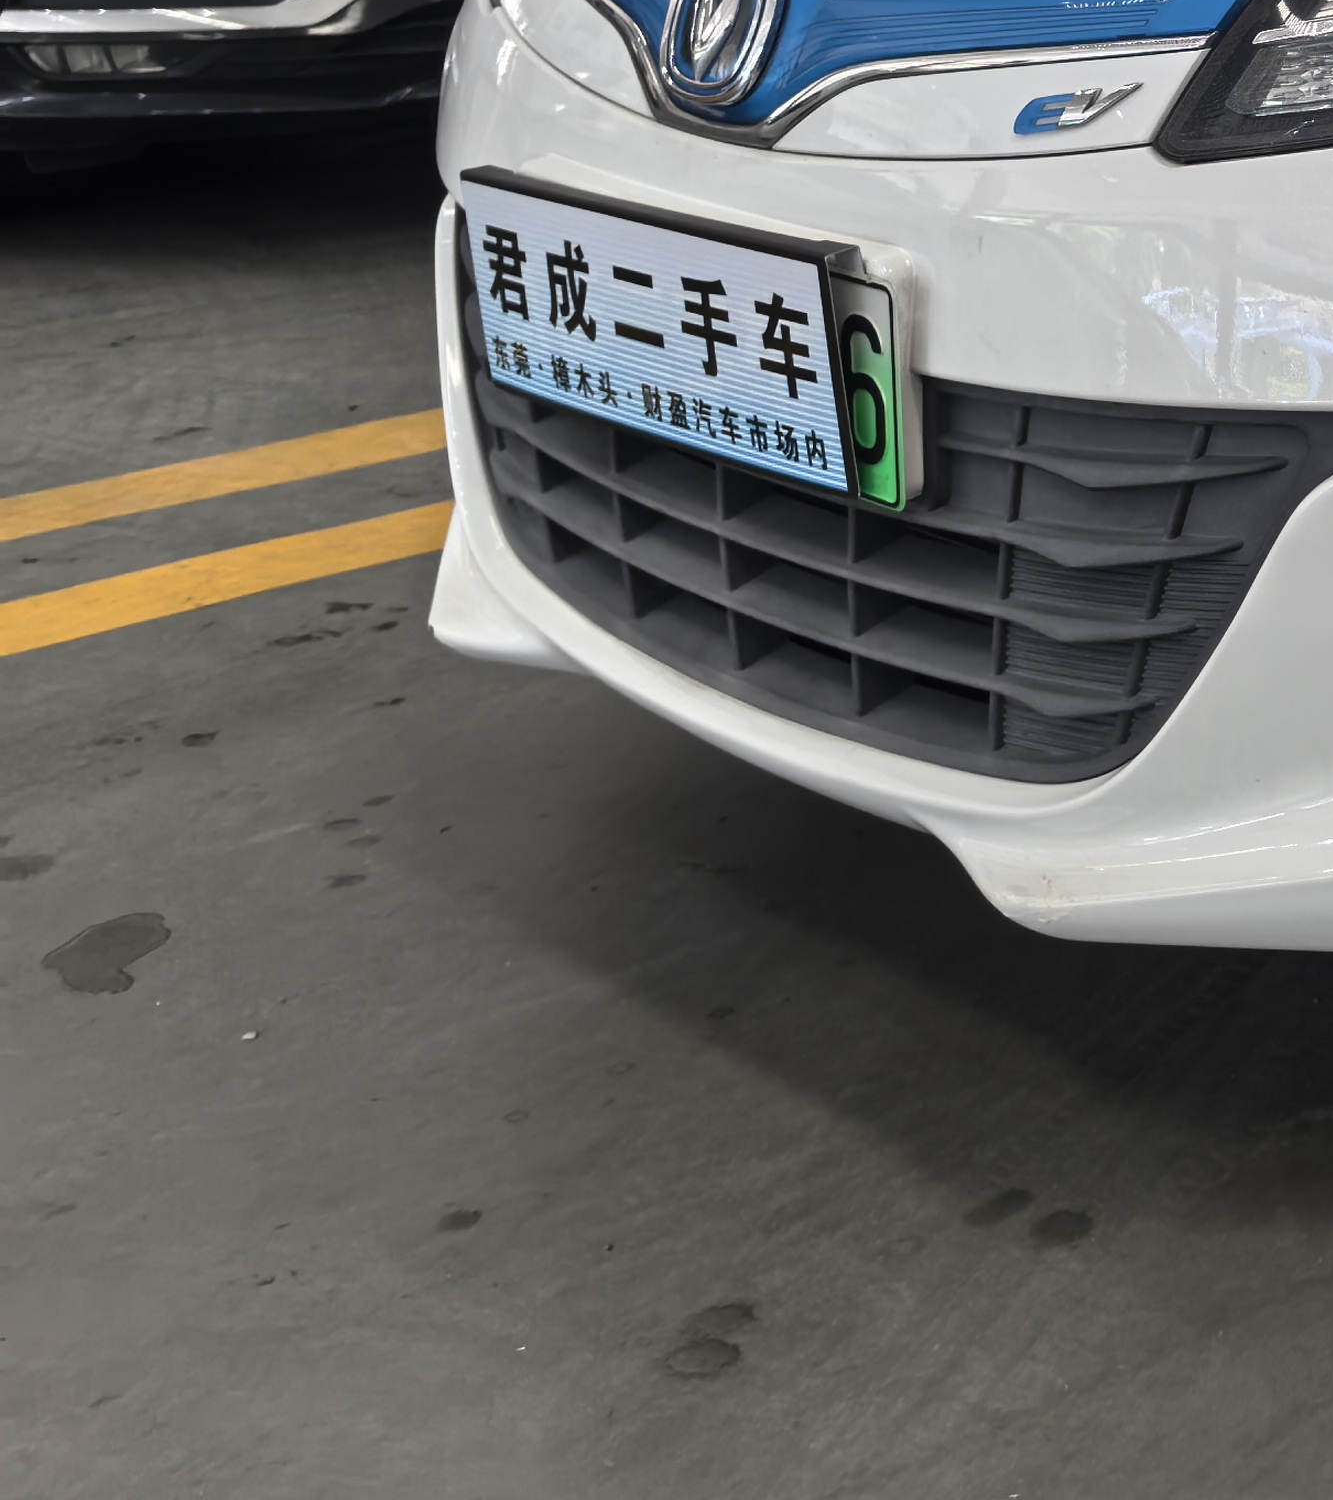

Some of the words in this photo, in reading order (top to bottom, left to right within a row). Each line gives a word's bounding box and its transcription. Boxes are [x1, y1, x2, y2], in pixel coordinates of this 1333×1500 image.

[1013, 81, 1144, 135] EV
[481, 223, 819, 399] 君成二手车
